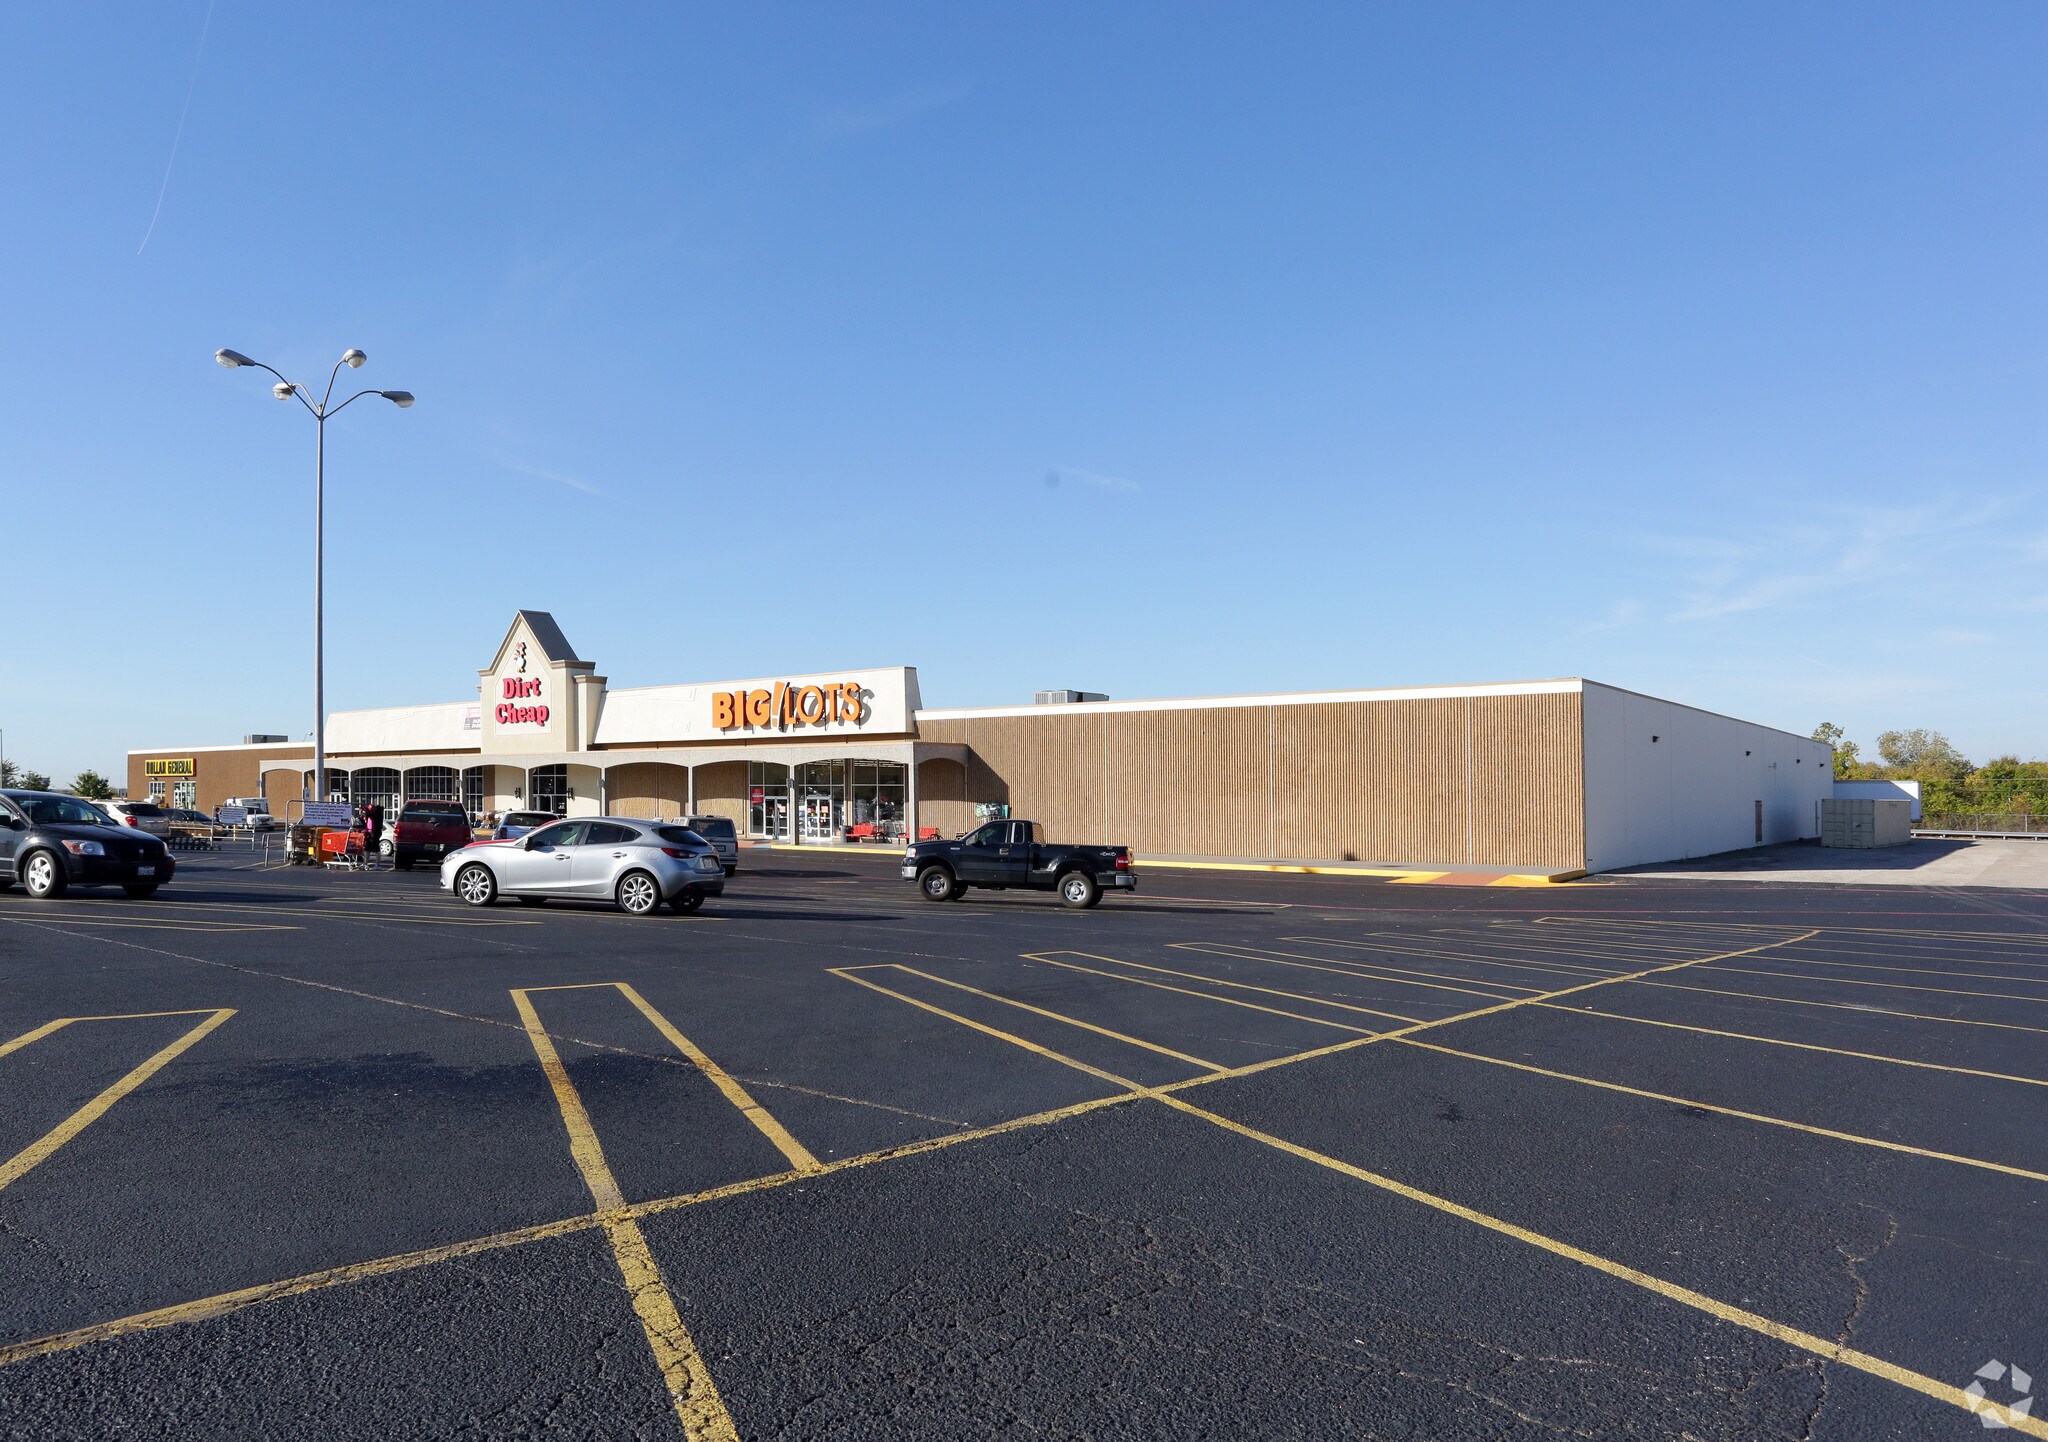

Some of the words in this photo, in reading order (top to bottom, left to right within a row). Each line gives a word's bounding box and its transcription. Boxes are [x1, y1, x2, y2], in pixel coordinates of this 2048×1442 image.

[503, 677, 541, 699] Dirt
[495, 703, 549, 727] Cheap
[784, 682, 861, 725] LOTS
